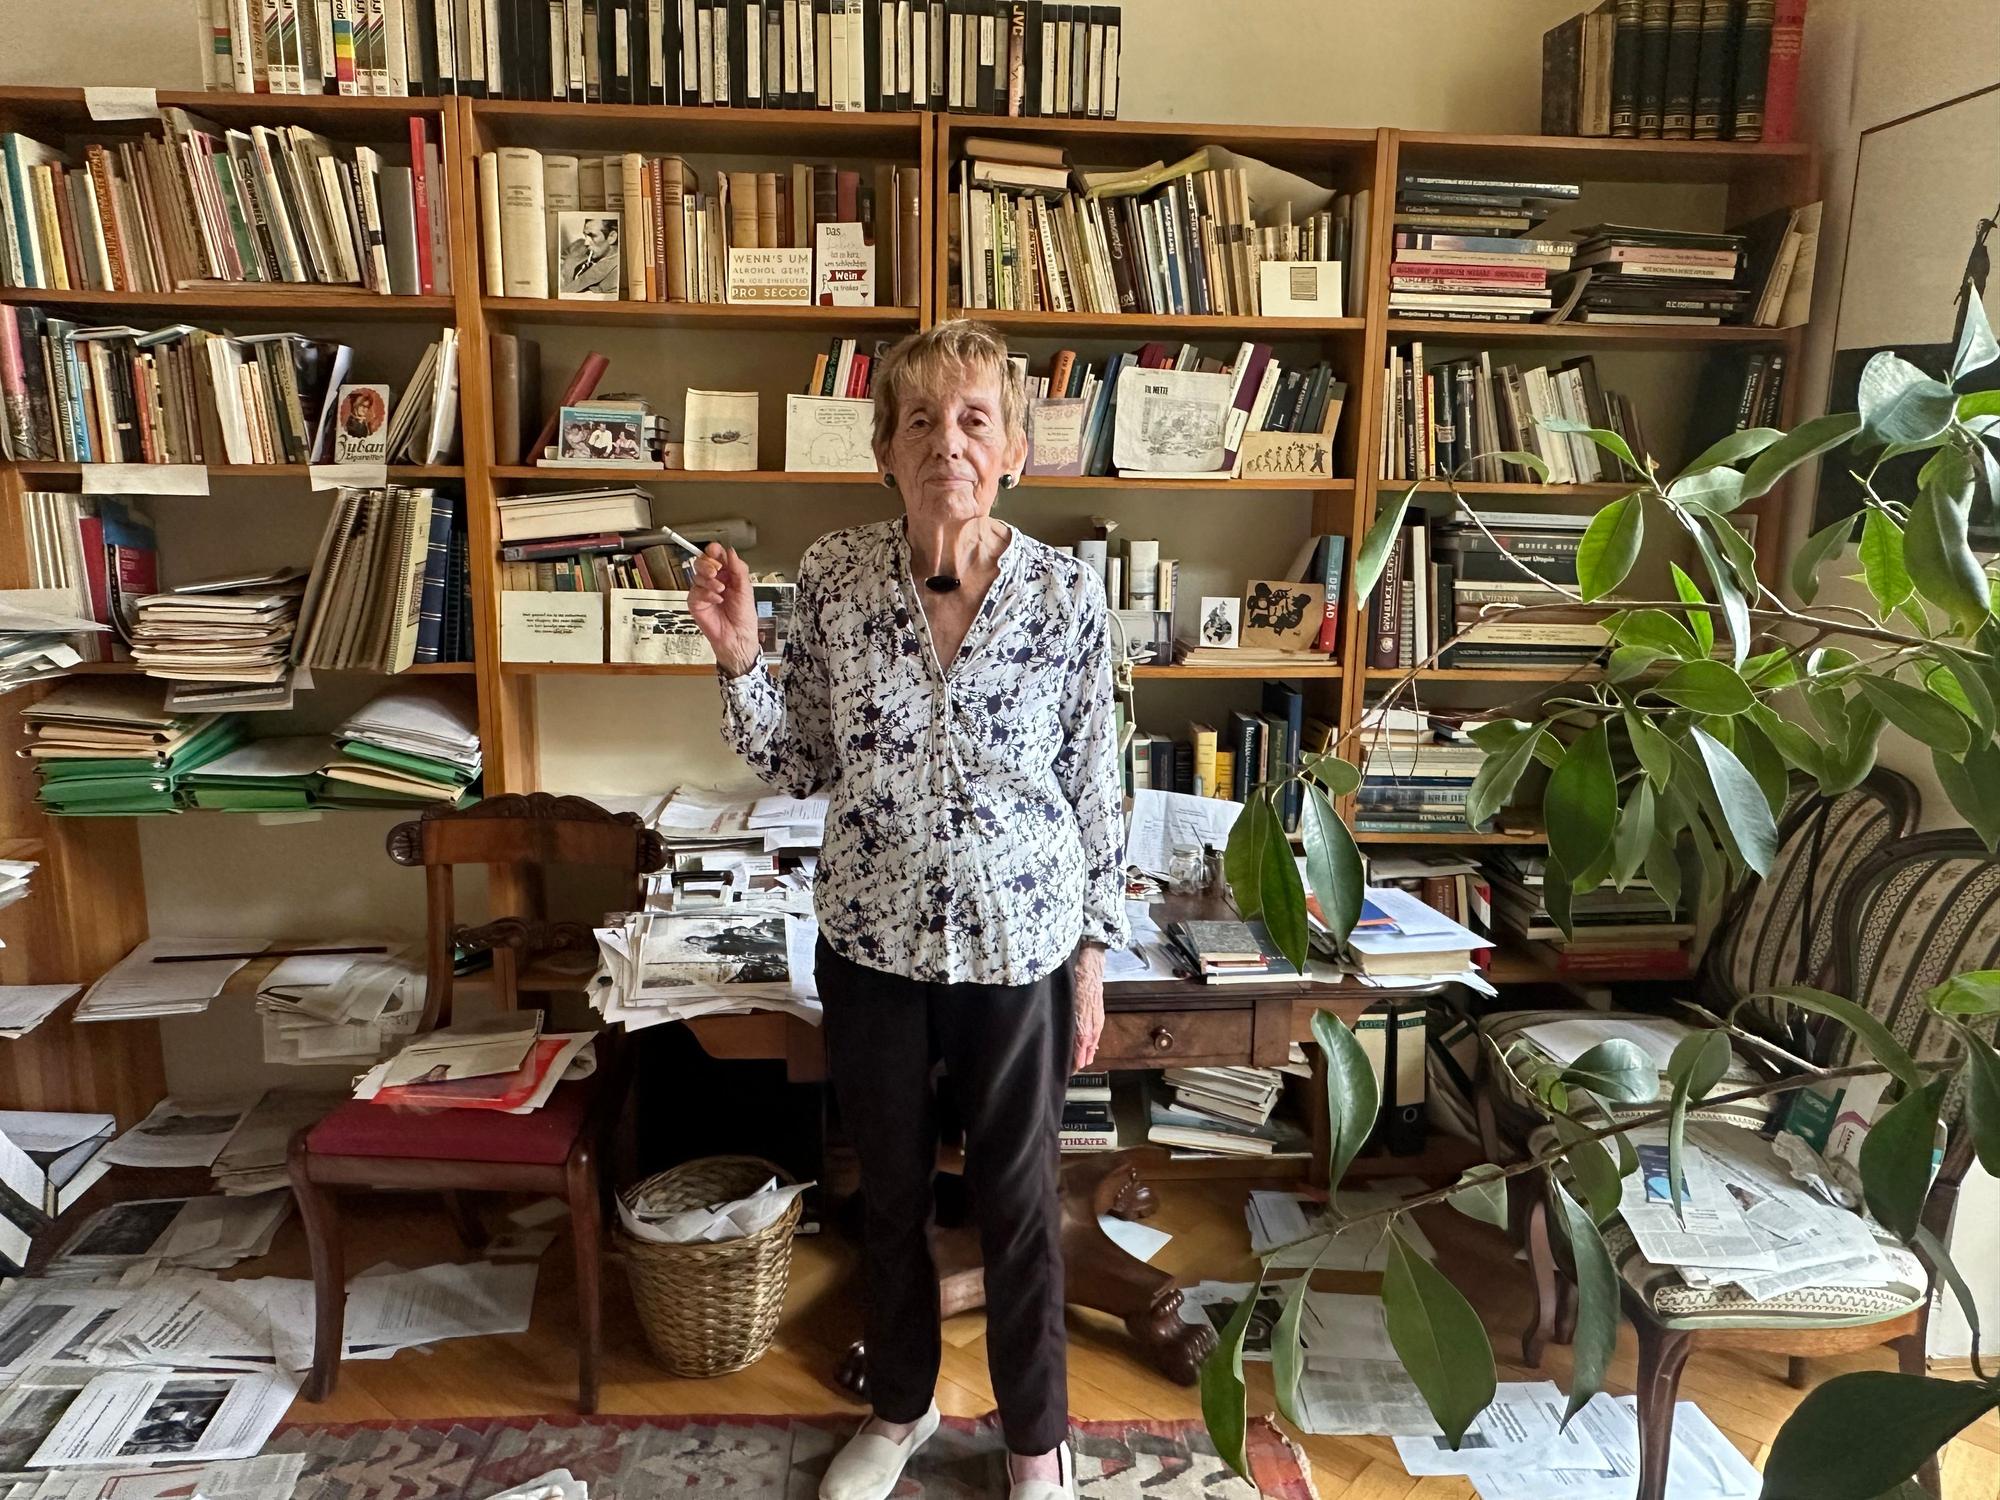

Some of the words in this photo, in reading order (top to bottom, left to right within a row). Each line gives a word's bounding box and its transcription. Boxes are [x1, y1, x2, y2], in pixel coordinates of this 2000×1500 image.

[1013, 5, 1024, 36] JVC
[826, 226, 841, 236] Das
[733, 254, 783, 263] WENN'S
[789, 254, 808, 263] UM
[835, 271, 857, 281] Wein
[731, 288, 757, 297] PRO
[764, 288, 808, 297] SECCO
[336, 434, 384, 461] Zuban
[1328, 577, 1338, 591] DE
[1326, 593, 1336, 618] STAD
[1061, 1137, 1107, 1145] THEATER
